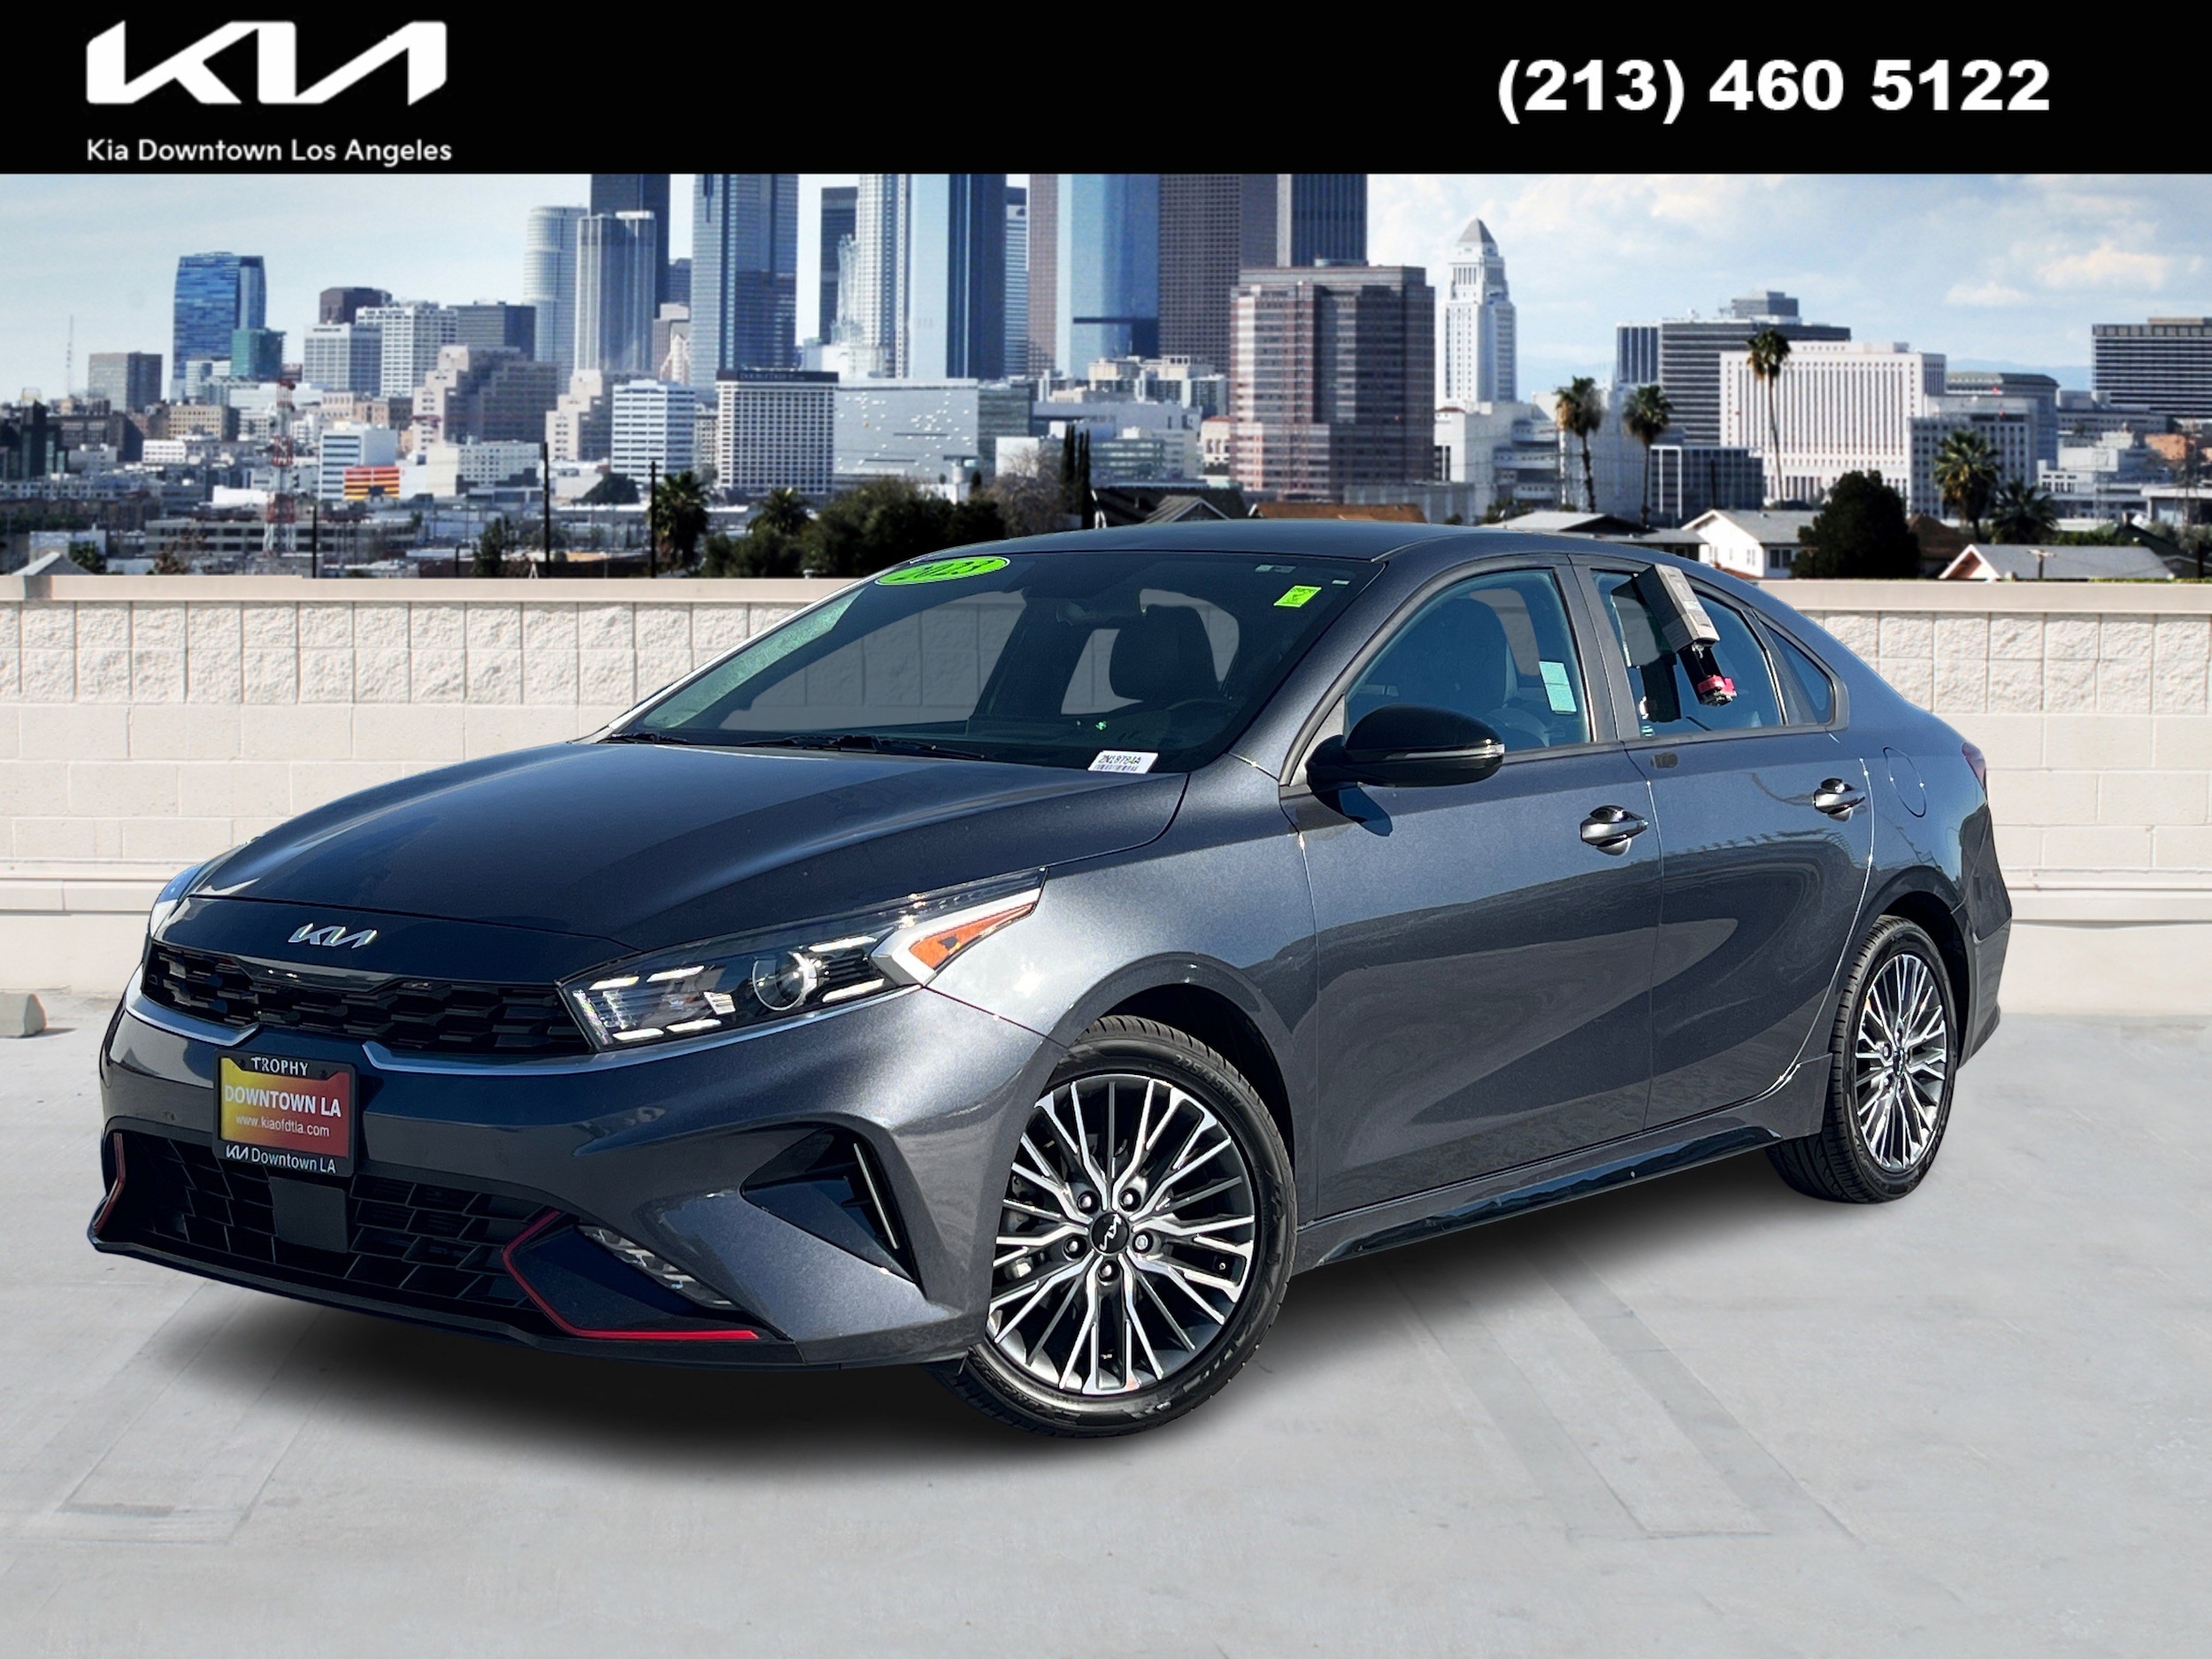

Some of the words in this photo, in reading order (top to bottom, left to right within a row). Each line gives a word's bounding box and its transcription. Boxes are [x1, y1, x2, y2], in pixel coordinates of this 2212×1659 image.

[888, 559, 997, 581] 2023
[288, 923, 378, 949] KIA
[250, 1056, 309, 1076] TROPHY
[224, 1085, 317, 1114] DOWNTOWN
[320, 1097, 342, 1118] LA
[235, 1115, 330, 1137] www.kiaofdtla.com
[251, 1148, 317, 1171] Downtown
[319, 1158, 336, 1173] LA
